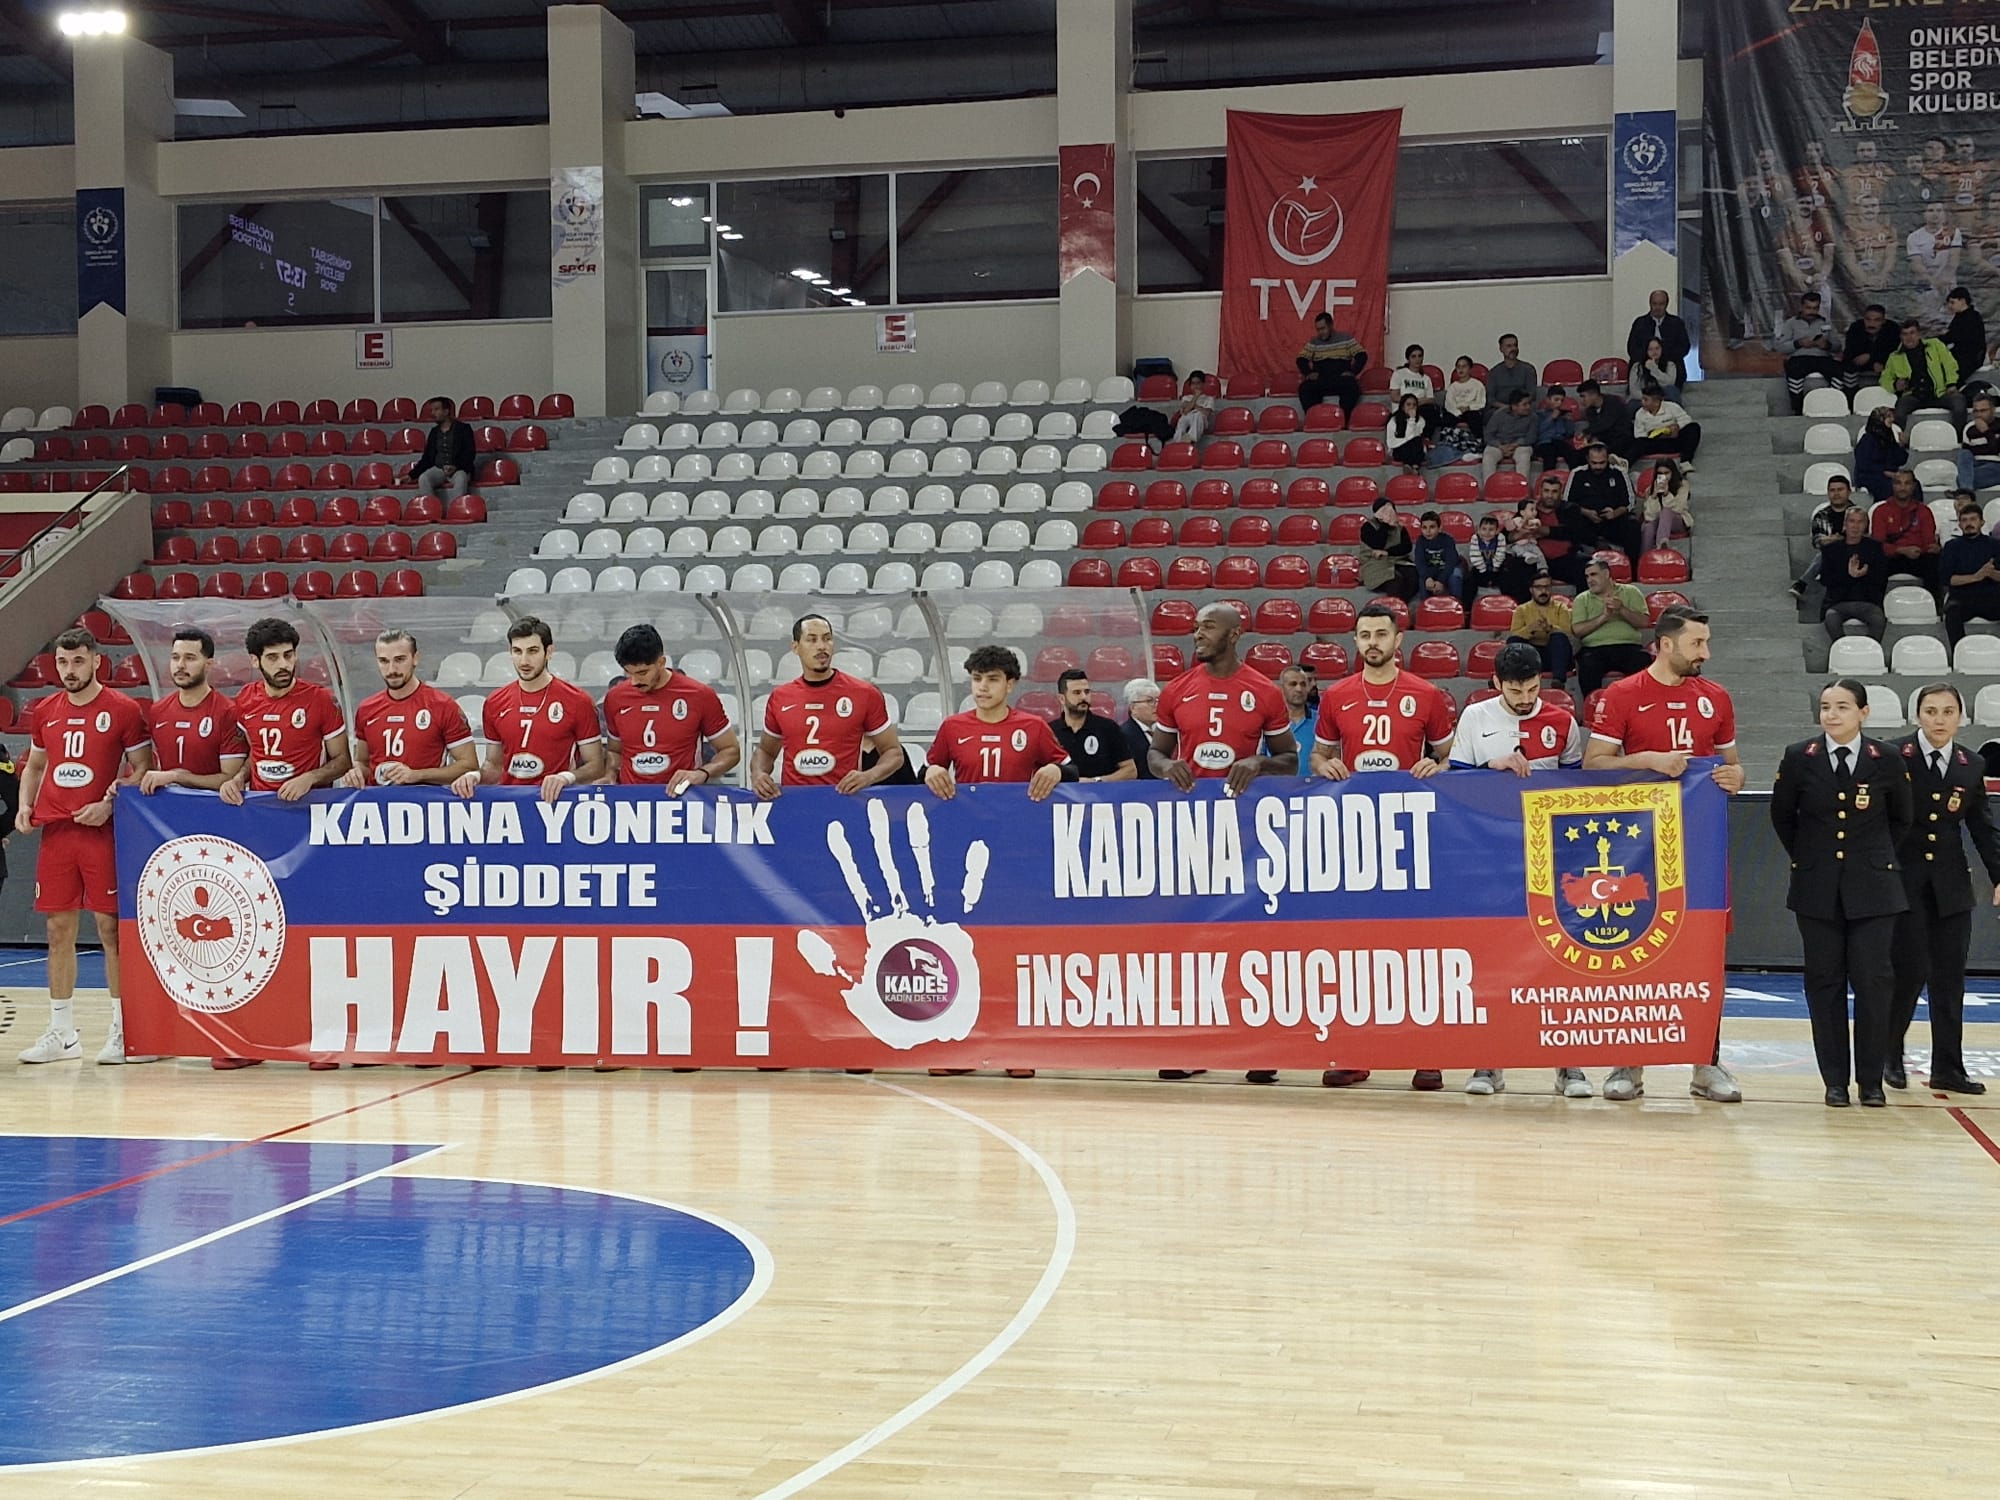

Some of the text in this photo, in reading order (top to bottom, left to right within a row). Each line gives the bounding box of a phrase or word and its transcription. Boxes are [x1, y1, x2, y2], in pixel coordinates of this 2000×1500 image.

[1910, 71, 1972, 91] SPOR
[1250, 278, 1357, 320] TVF
[885, 315, 906, 342] E
[364, 332, 384, 359] E
[520, 719, 533, 748] 7
[643, 719, 656, 748] 6
[805, 715, 820, 745] 2
[1208, 706, 1224, 737] 5
[1362, 714, 1391, 746] 20
[1666, 717, 1694, 750] 14
[63, 730, 85, 758] 10
[175, 735, 184, 764] 1
[258, 727, 283, 756] 12
[382, 728, 404, 757] 16
[1200, 748, 1230, 760] MADO
[58, 769, 87, 778] MADO
[636, 755, 664, 765] MADO
[800, 754, 829, 766] MADO
[979, 747, 1002, 778] 11
[1362, 756, 1393, 768] MADO
[309, 793, 775, 845] KADINA YÖNELİK
[1052, 791, 1436, 915] KADINA ŞİDDET
[423, 856, 657, 916] ŞİDDETE
[1537, 909, 1678, 971] JANDARMA
[309, 935, 774, 1056] HAYIR !
[884, 975, 949, 994] KADES
[914, 993, 949, 1003] DESTEK
[1015, 948, 1488, 1042] İNSANLIK SUÇUDUR.
[1510, 981, 1711, 1005] KAHRAMANMARAŞ
[1540, 1003, 1683, 1026] İL JANDARMA
[1539, 1022, 1687, 1047] KOMUTANLIĞI
